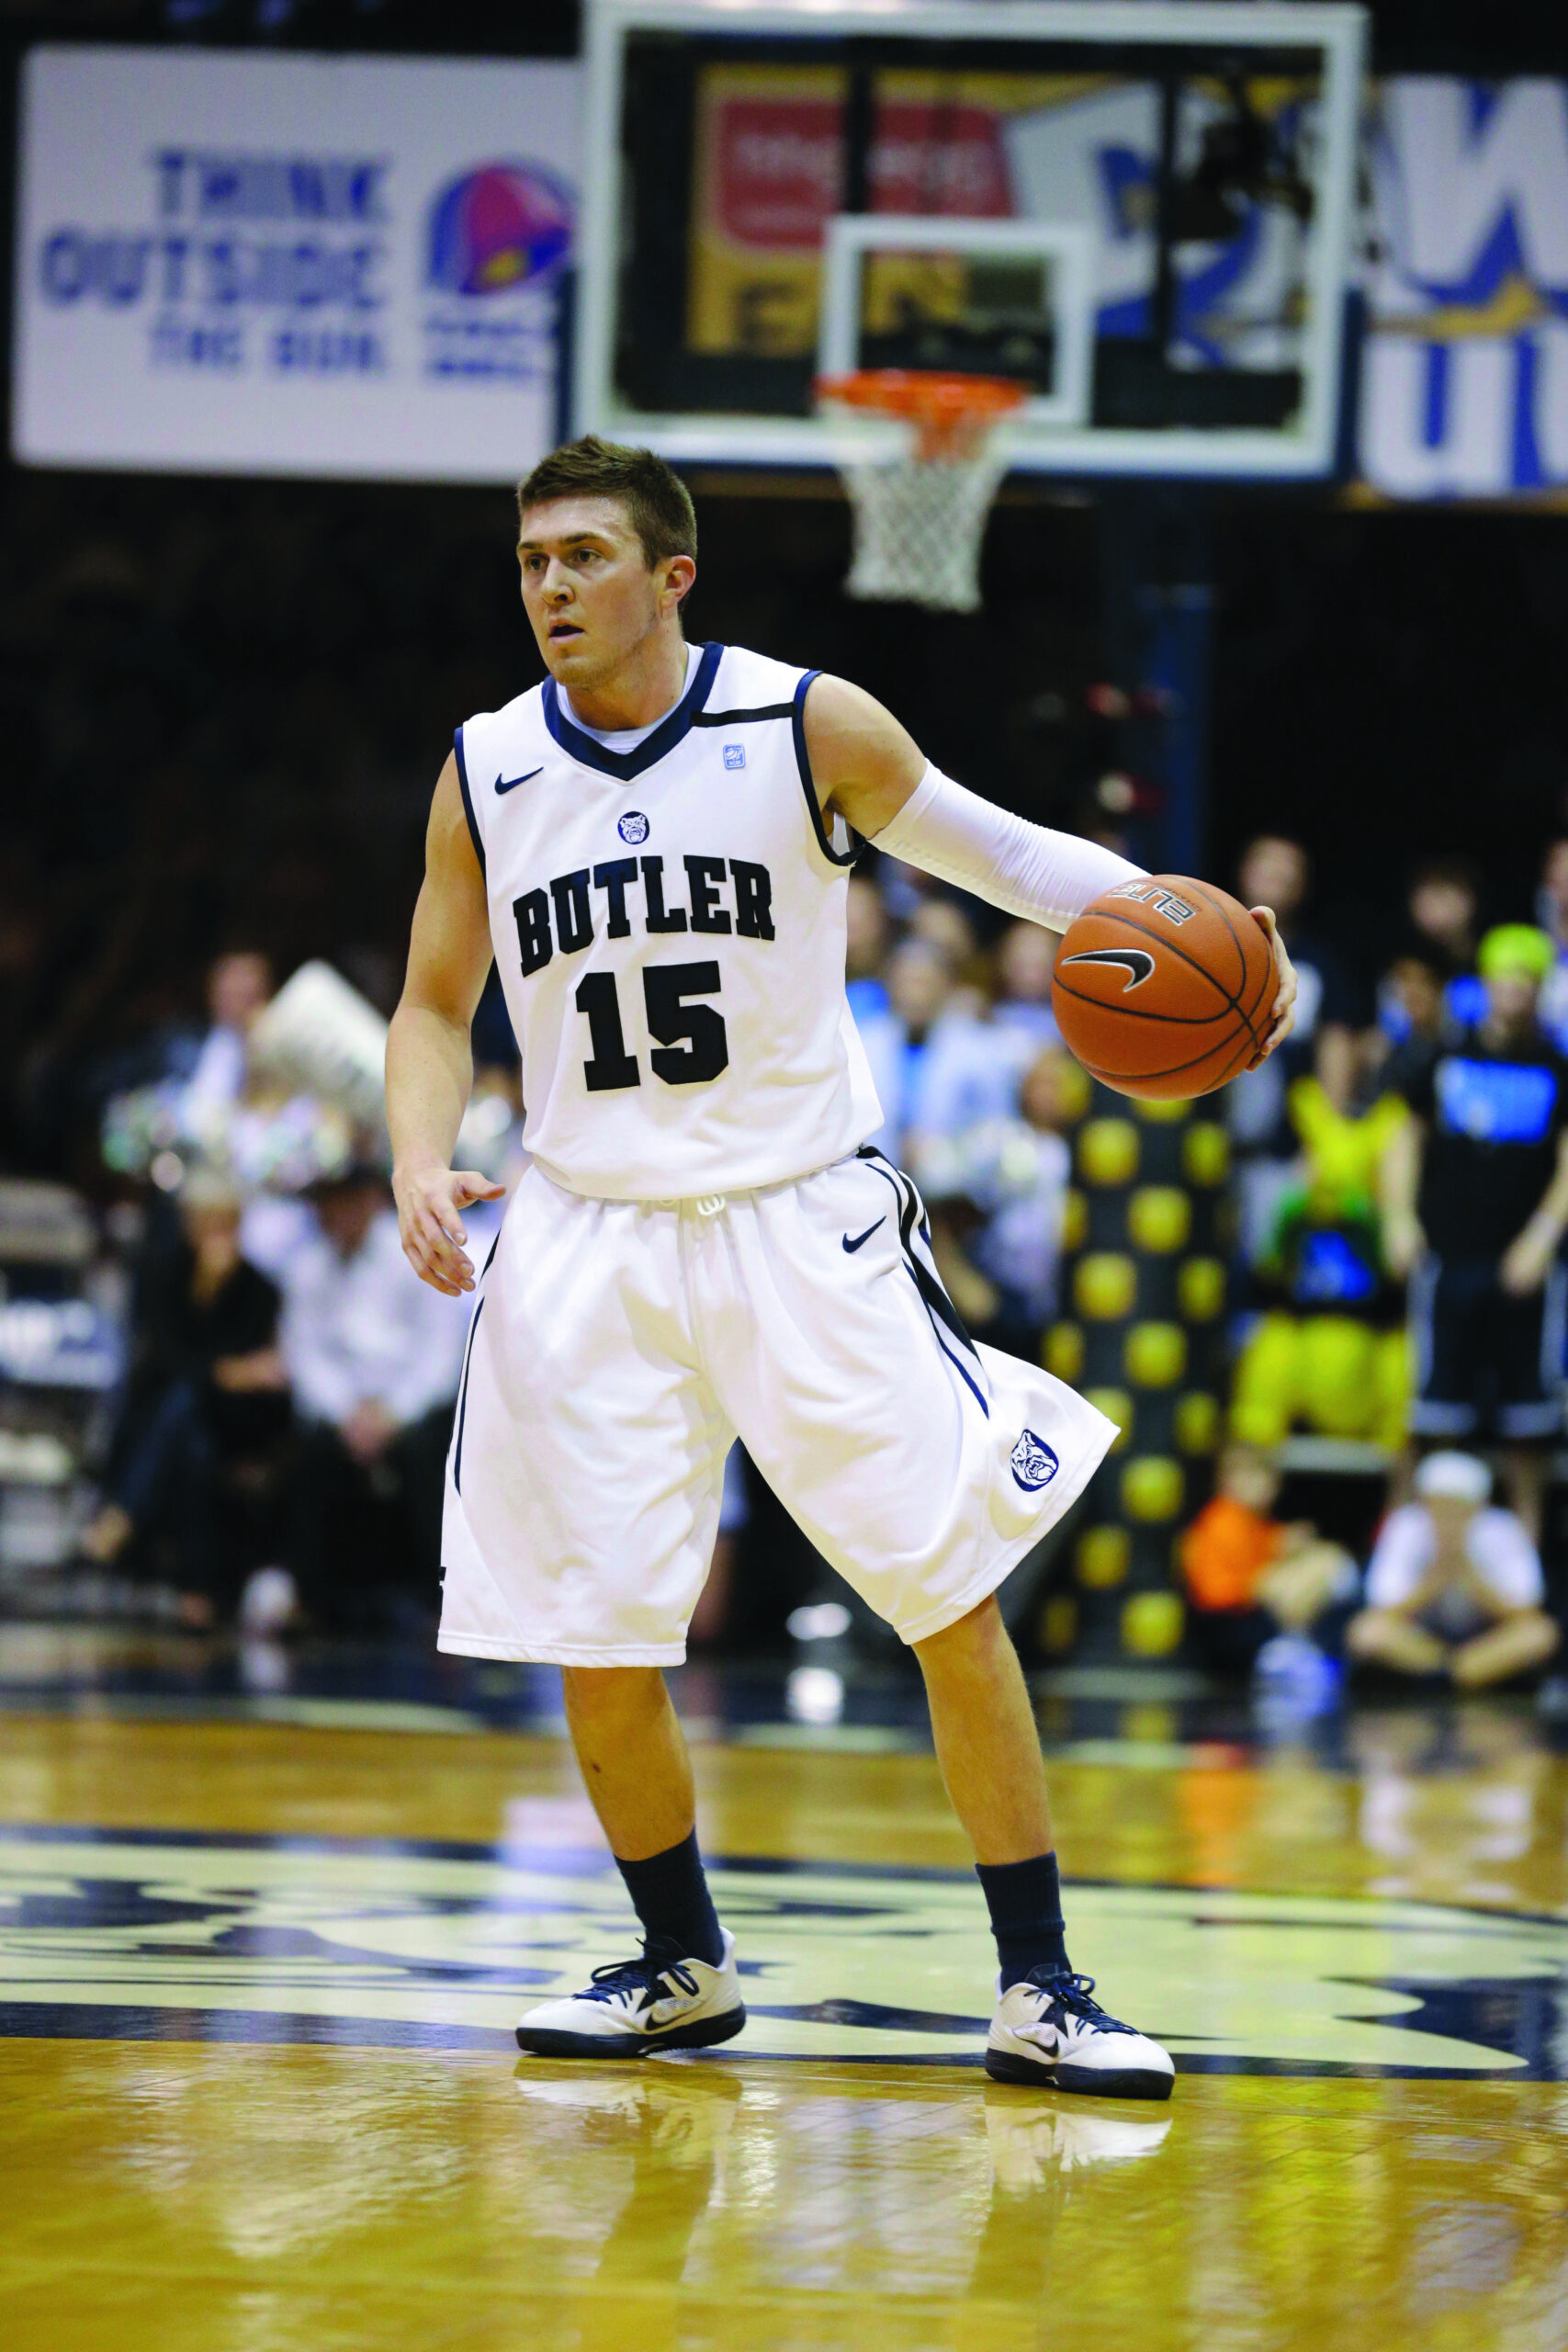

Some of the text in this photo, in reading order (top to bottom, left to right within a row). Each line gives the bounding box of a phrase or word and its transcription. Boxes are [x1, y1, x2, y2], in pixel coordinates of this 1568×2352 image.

[154, 149, 390, 221] THINK
[42, 226, 384, 309] OUTSIDE
[513, 854, 776, 978] BUTLER
[1106, 883, 1196, 926] ELITE
[574, 959, 729, 1091] 15
